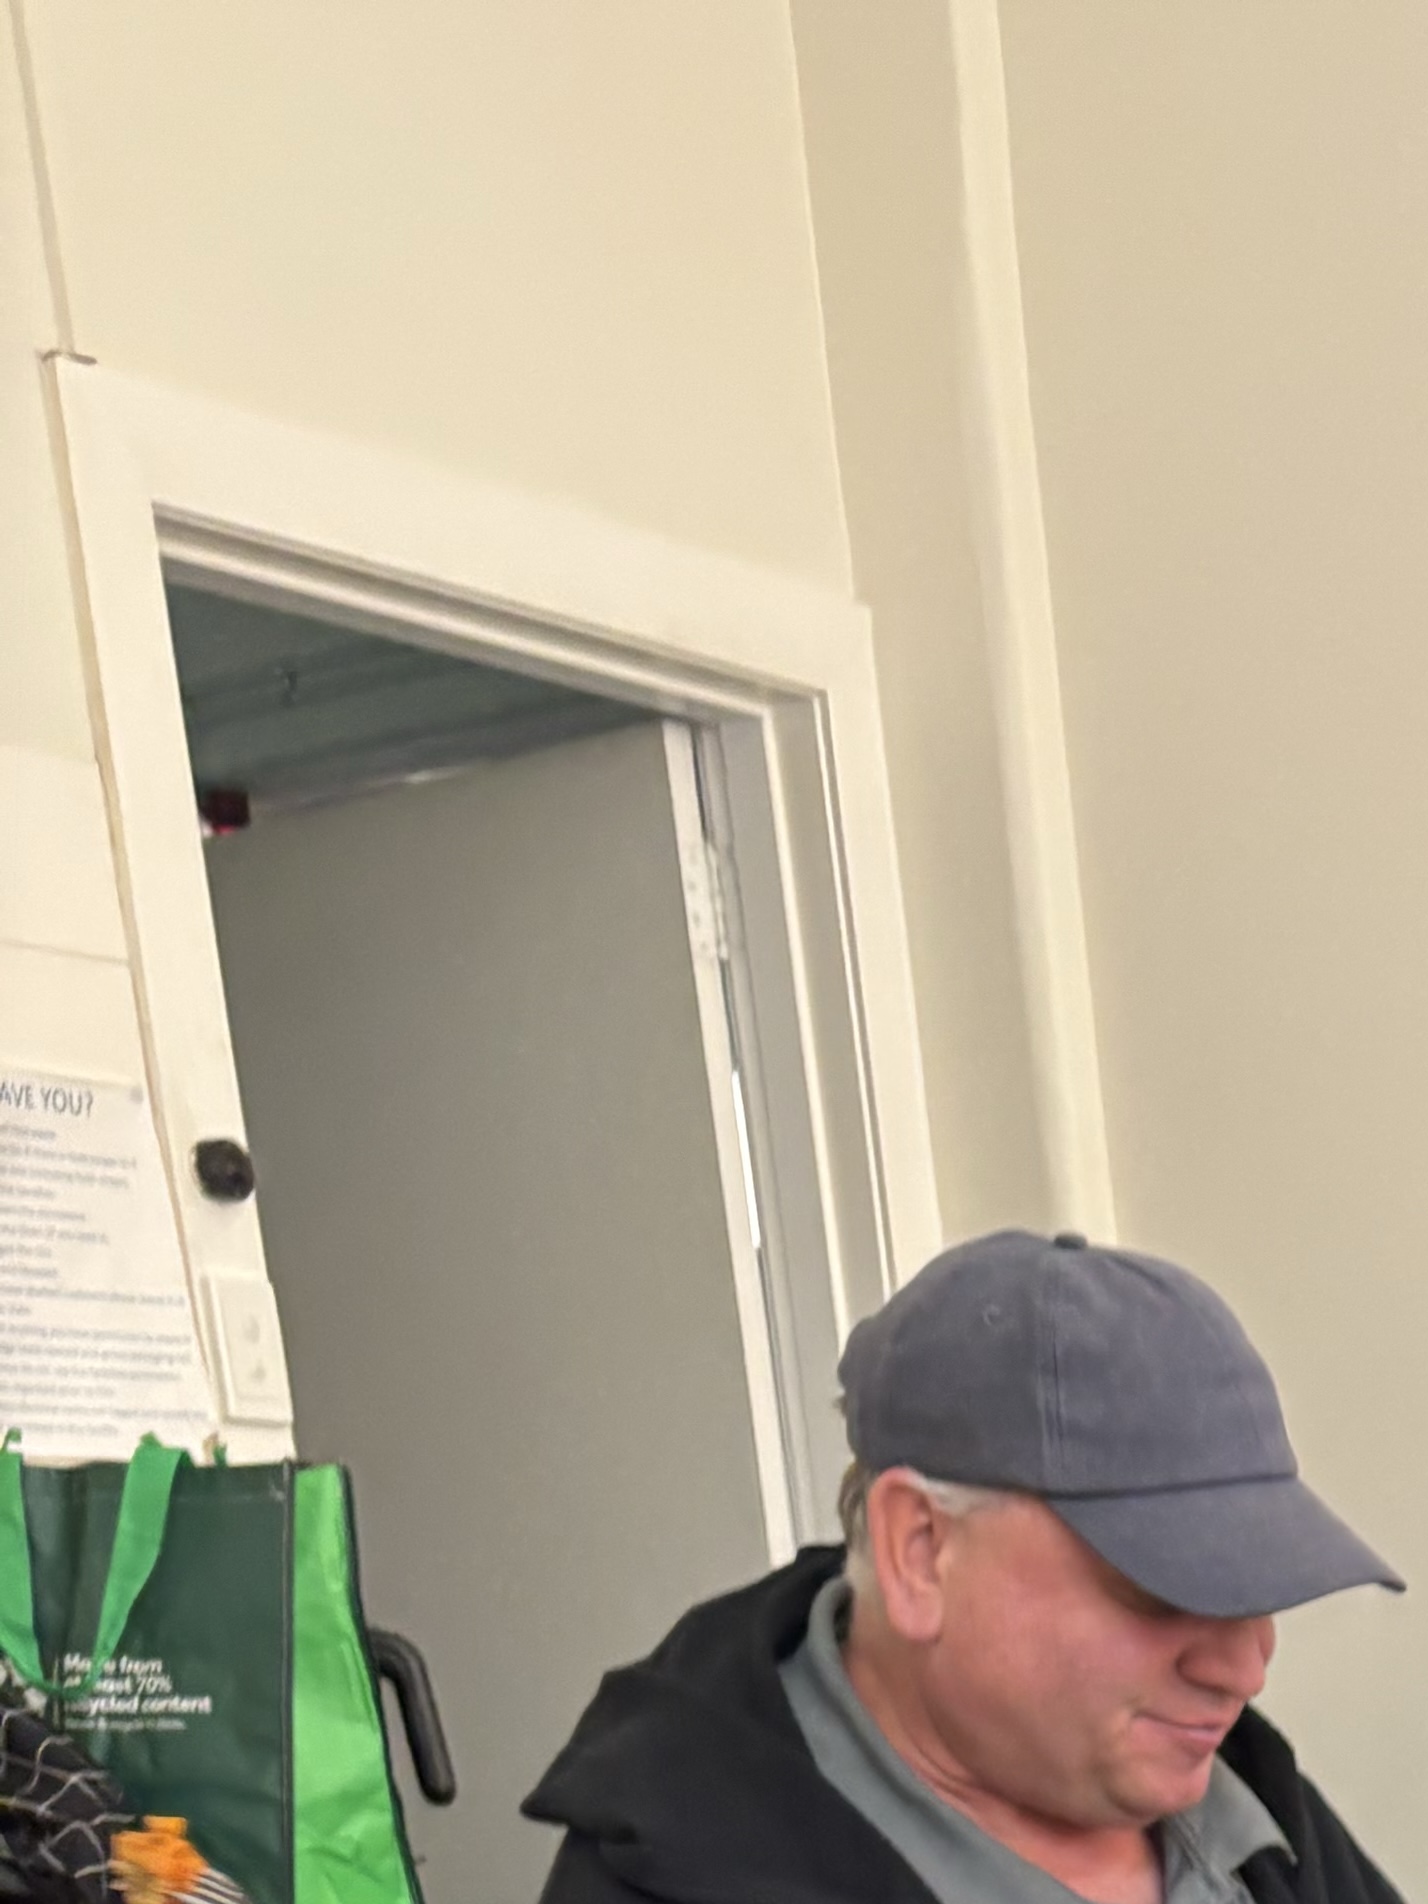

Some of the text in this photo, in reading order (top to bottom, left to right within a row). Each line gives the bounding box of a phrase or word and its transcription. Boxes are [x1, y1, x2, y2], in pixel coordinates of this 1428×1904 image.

[40, 1087, 94, 1118] YOU?
[64, 1653, 162, 1675] Mae from
[92, 1675, 132, 1695] east
[136, 1674, 173, 1697] 70%
[141, 1696, 212, 1715] content
